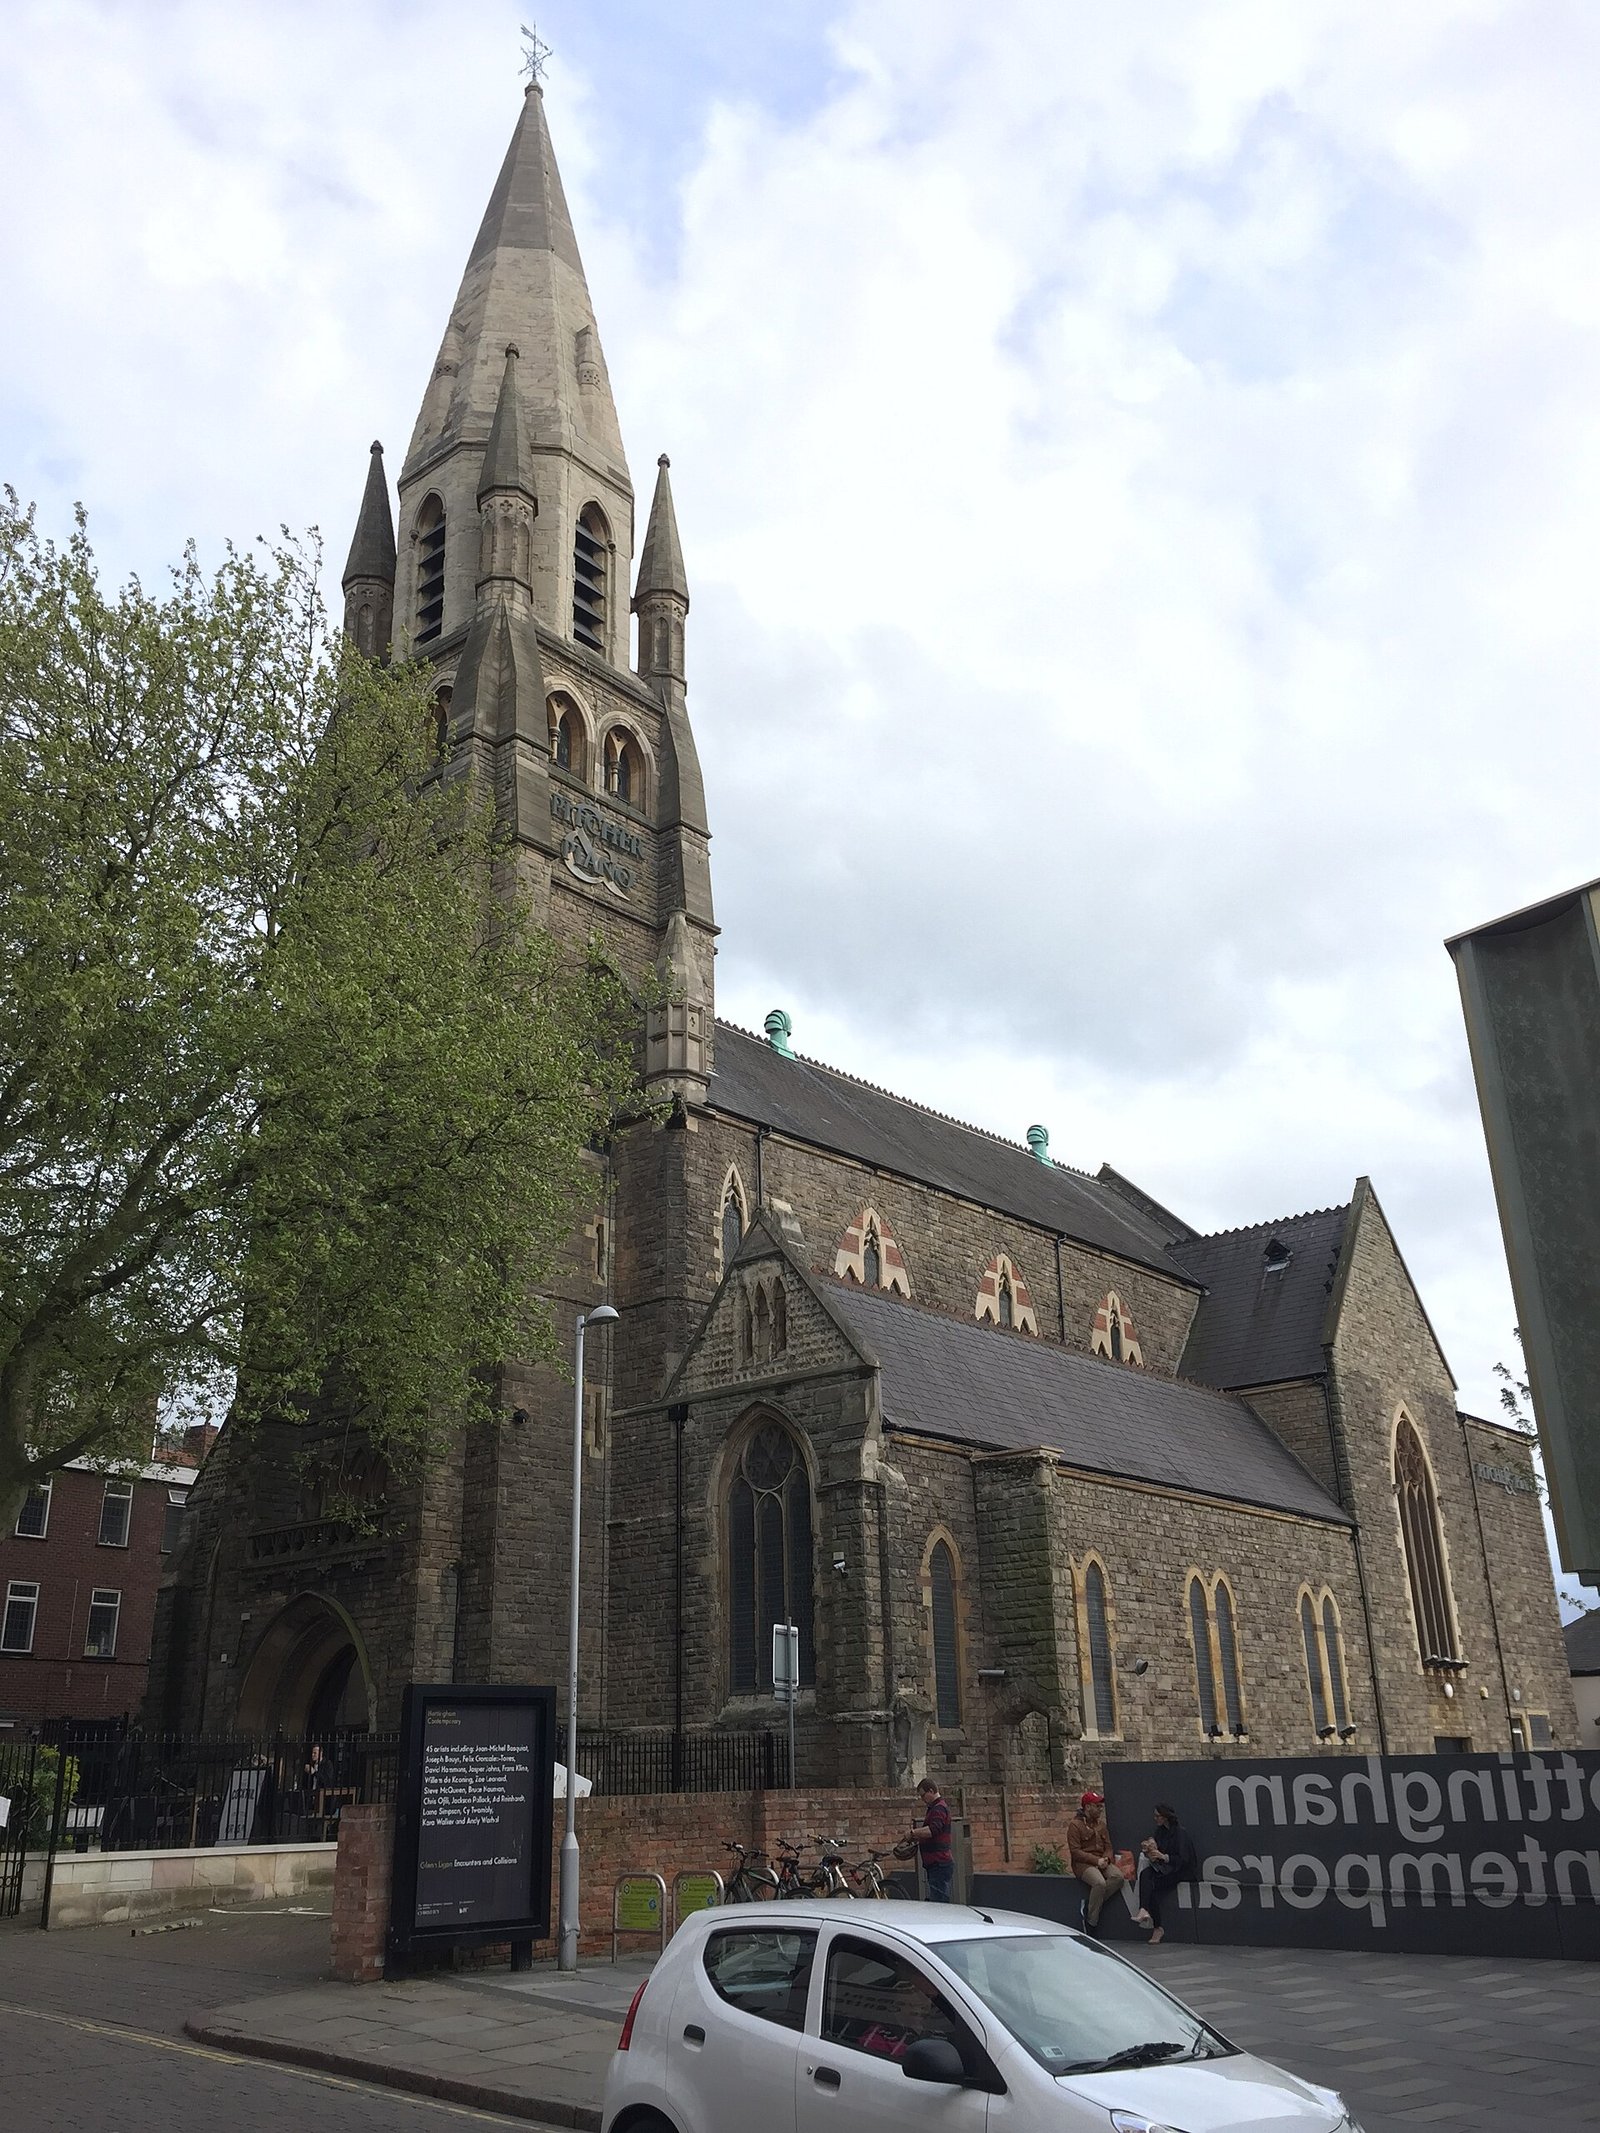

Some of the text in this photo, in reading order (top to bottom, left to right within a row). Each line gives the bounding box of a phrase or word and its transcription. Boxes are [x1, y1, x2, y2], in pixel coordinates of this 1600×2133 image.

[551, 793, 646, 861] PITCHER
[475, 1744, 506, 1752] Jean-Michel
[426, 1755, 444, 1764] Joseph
[462, 1755, 475, 1763] Felix
[468, 1766, 485, 1774] Jasper
[425, 1776, 442, 1784] Willem
[451, 1775, 474, 1785] Kooning,
[439, 1786, 467, 1794] McQueen,
[468, 1785, 482, 1793] Bruce
[483, 1785, 506, 1793] Nauman,
[424, 1797, 437, 1805] Chris
[451, 1796, 472, 1804] Jackson
[472, 1795, 492, 1804] Pollock,
[492, 1795, 500, 1803] Ad
[438, 1807, 462, 1816] Simpson,
[462, 1806, 470, 1815] Cy
[423, 1815, 500, 1826] Kara Walker and Andy Warhol
[454, 1858, 481, 1867] Encounters
[482, 1858, 493, 1866] and
[493, 1856, 517, 1865] Collisions
